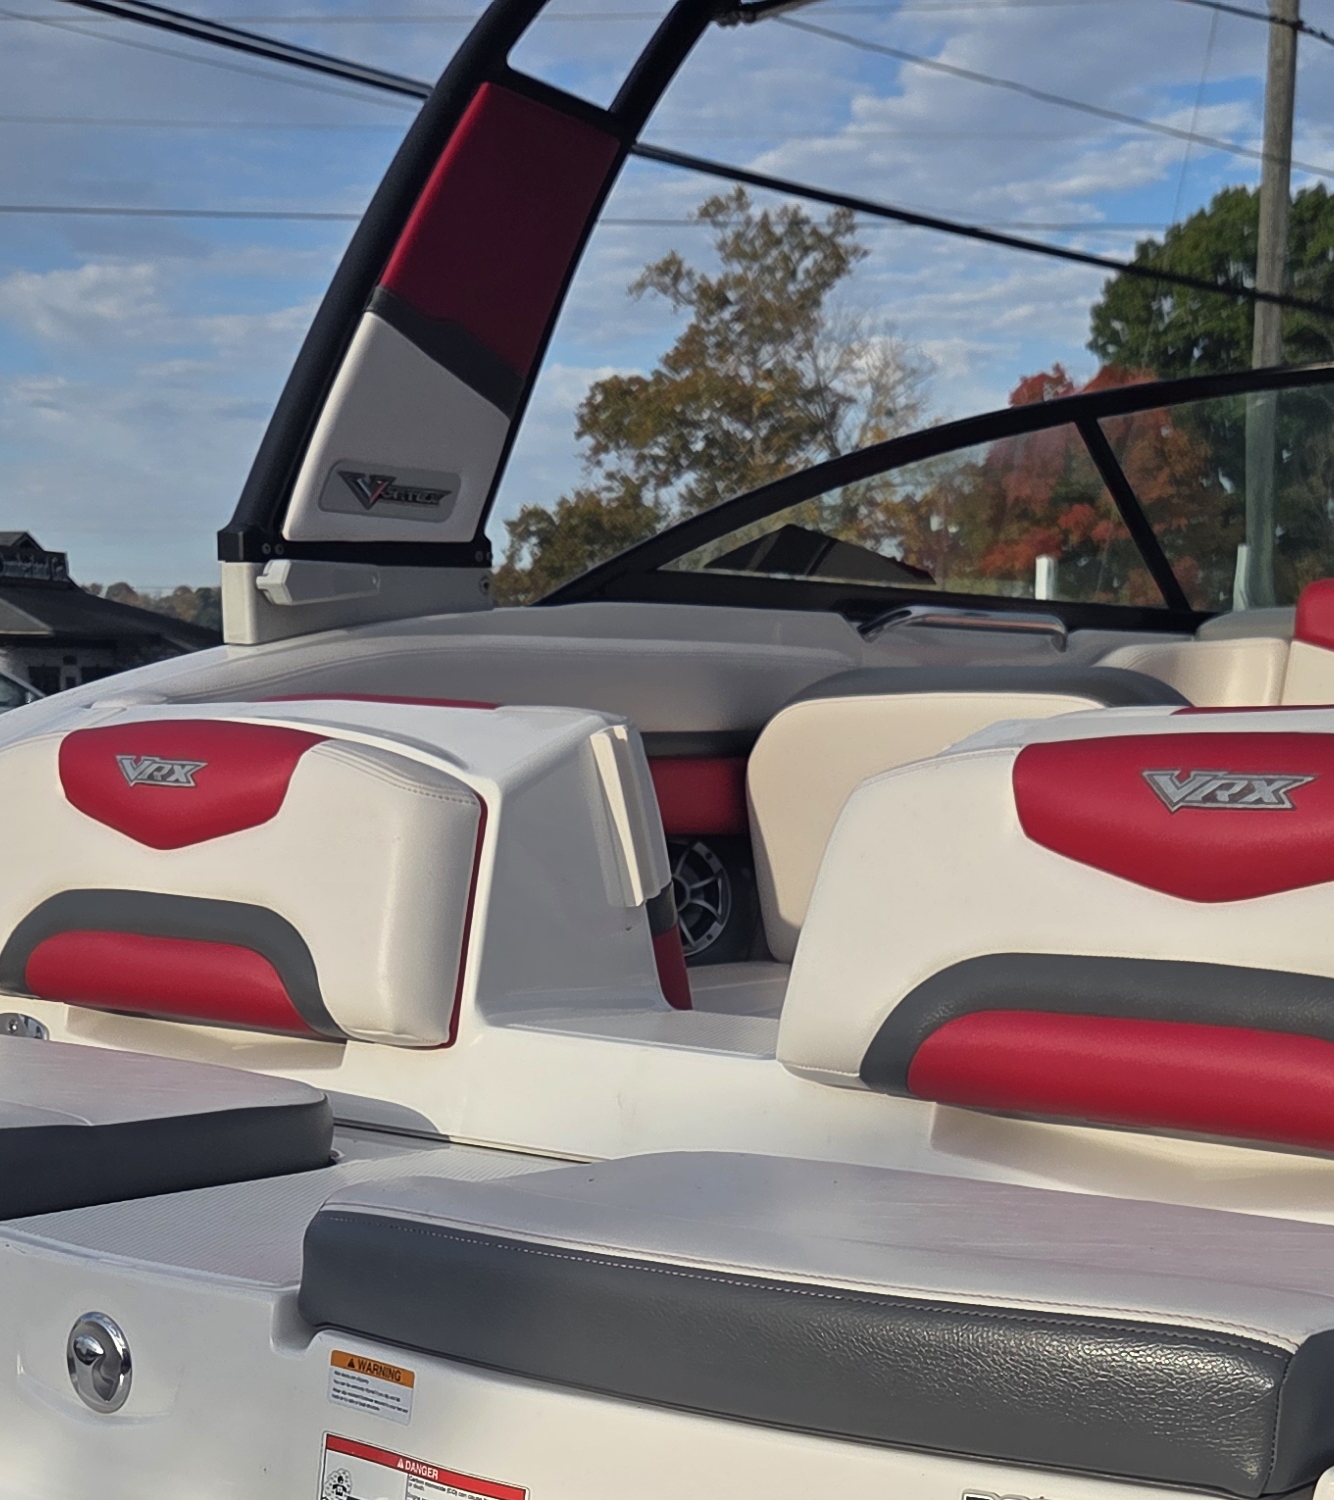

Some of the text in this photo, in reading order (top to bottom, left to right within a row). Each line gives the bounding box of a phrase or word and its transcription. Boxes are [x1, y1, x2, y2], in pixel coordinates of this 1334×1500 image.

[116, 755, 208, 787] VRX
[1142, 770, 1317, 813] VRX
[357, 1358, 402, 1382] WARNING
[404, 1460, 438, 1480] DANGER
